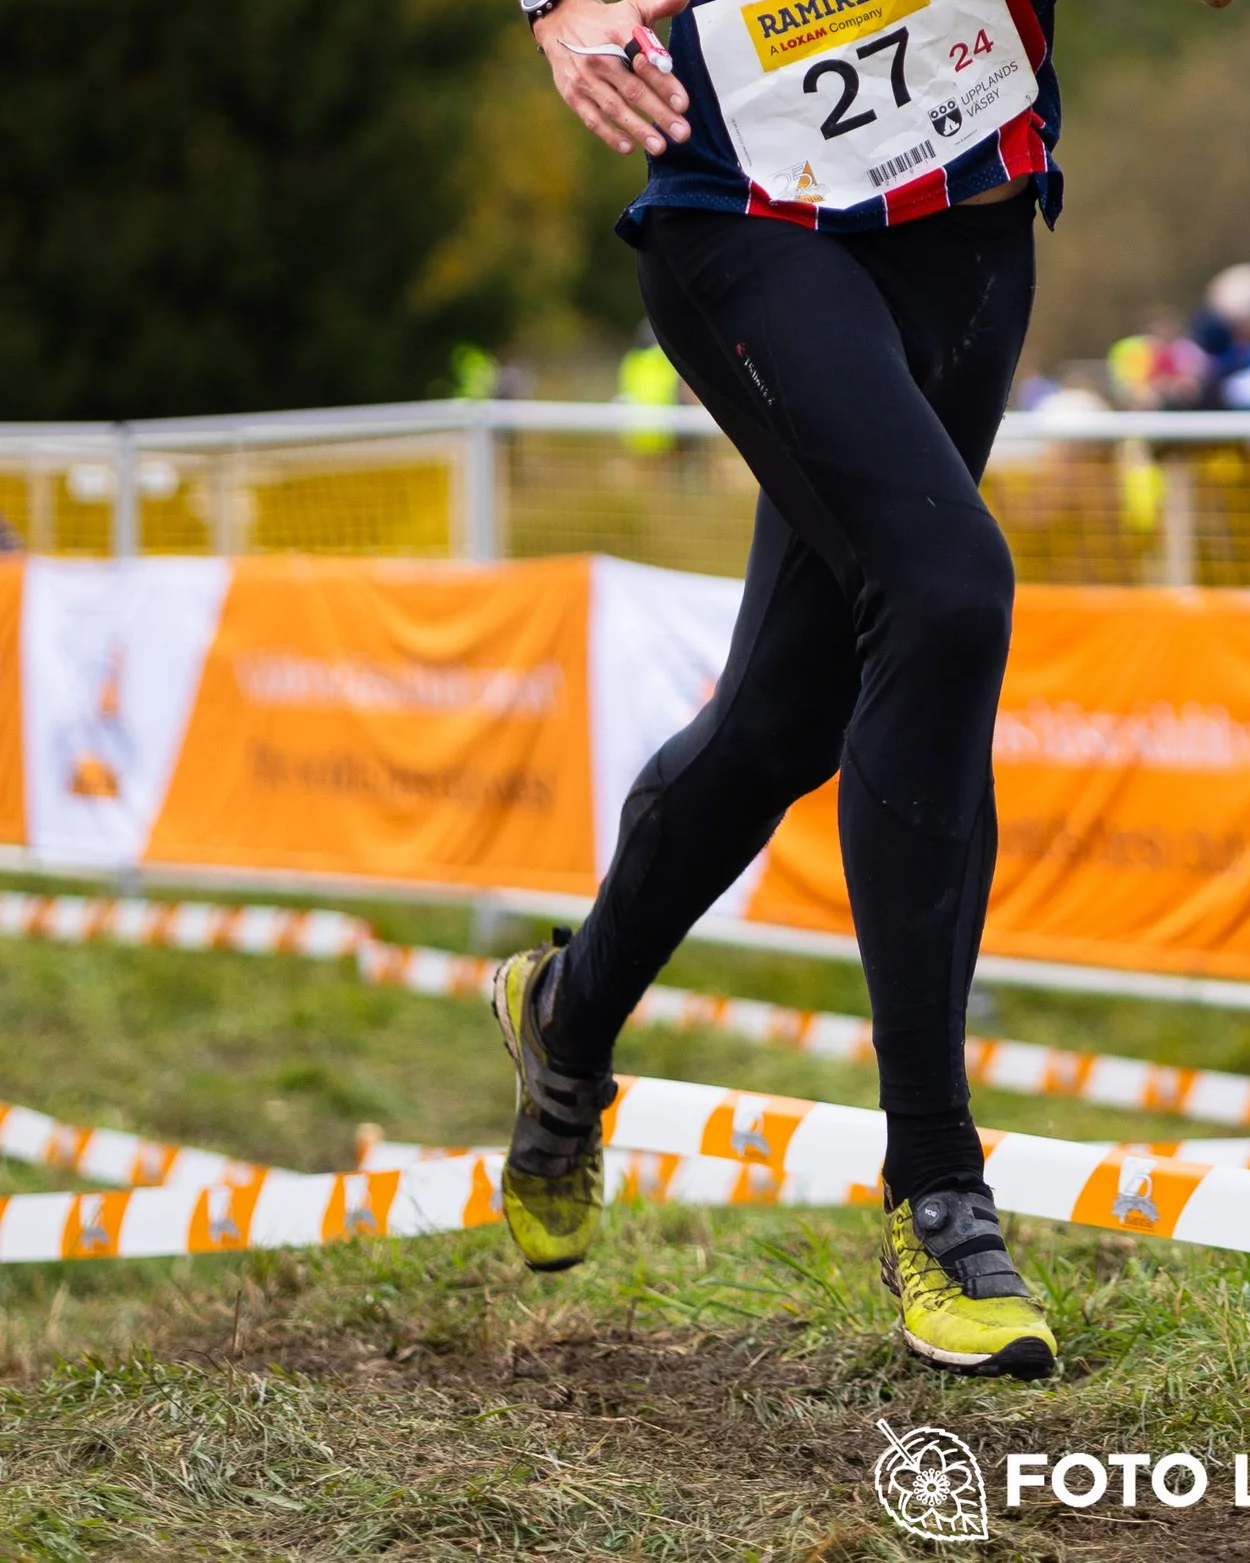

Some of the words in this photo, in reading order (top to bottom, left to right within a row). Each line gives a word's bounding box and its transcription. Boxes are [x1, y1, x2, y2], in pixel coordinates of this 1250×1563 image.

[770, 45, 779, 56] A
[781, 28, 828, 52] LOXAM
[829, 8, 883, 33] Company
[950, 28, 994, 72] 24
[803, 26, 912, 140] 27
[961, 61, 1019, 106] UPPLANDS
[966, 87, 1001, 118] VÄSBY
